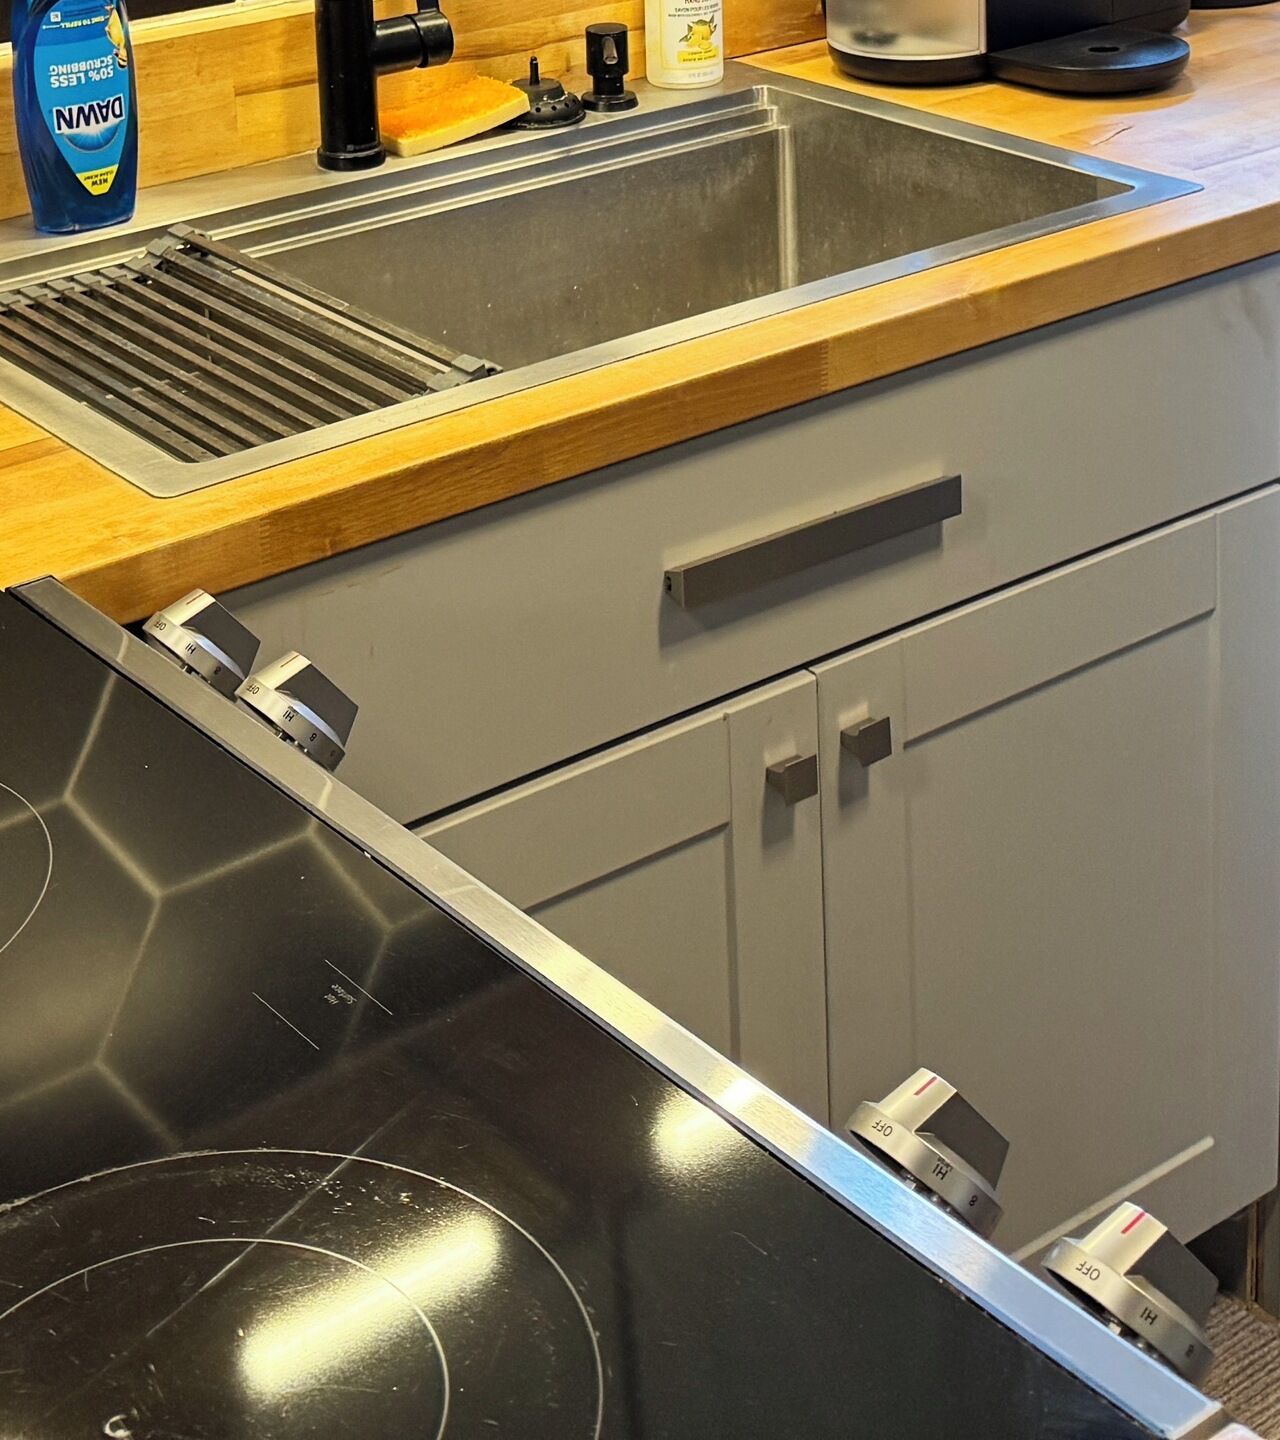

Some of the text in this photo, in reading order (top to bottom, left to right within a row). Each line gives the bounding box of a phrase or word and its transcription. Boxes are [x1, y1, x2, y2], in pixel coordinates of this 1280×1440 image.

[49, 55, 113, 75] SCRUBBING
[50, 65, 114, 88] 50% LESS
[55, 95, 123, 131] DAWN
[91, 177, 108, 187] NEW
[185, 643, 197, 654] HI
[282, 710, 295, 722] HI
[871, 1119, 893, 1137] OFF
[932, 1163, 949, 1180] HI
[968, 1194, 978, 1206] 8
[1075, 1260, 1101, 1281] OFF
[1140, 1307, 1159, 1325] HI
